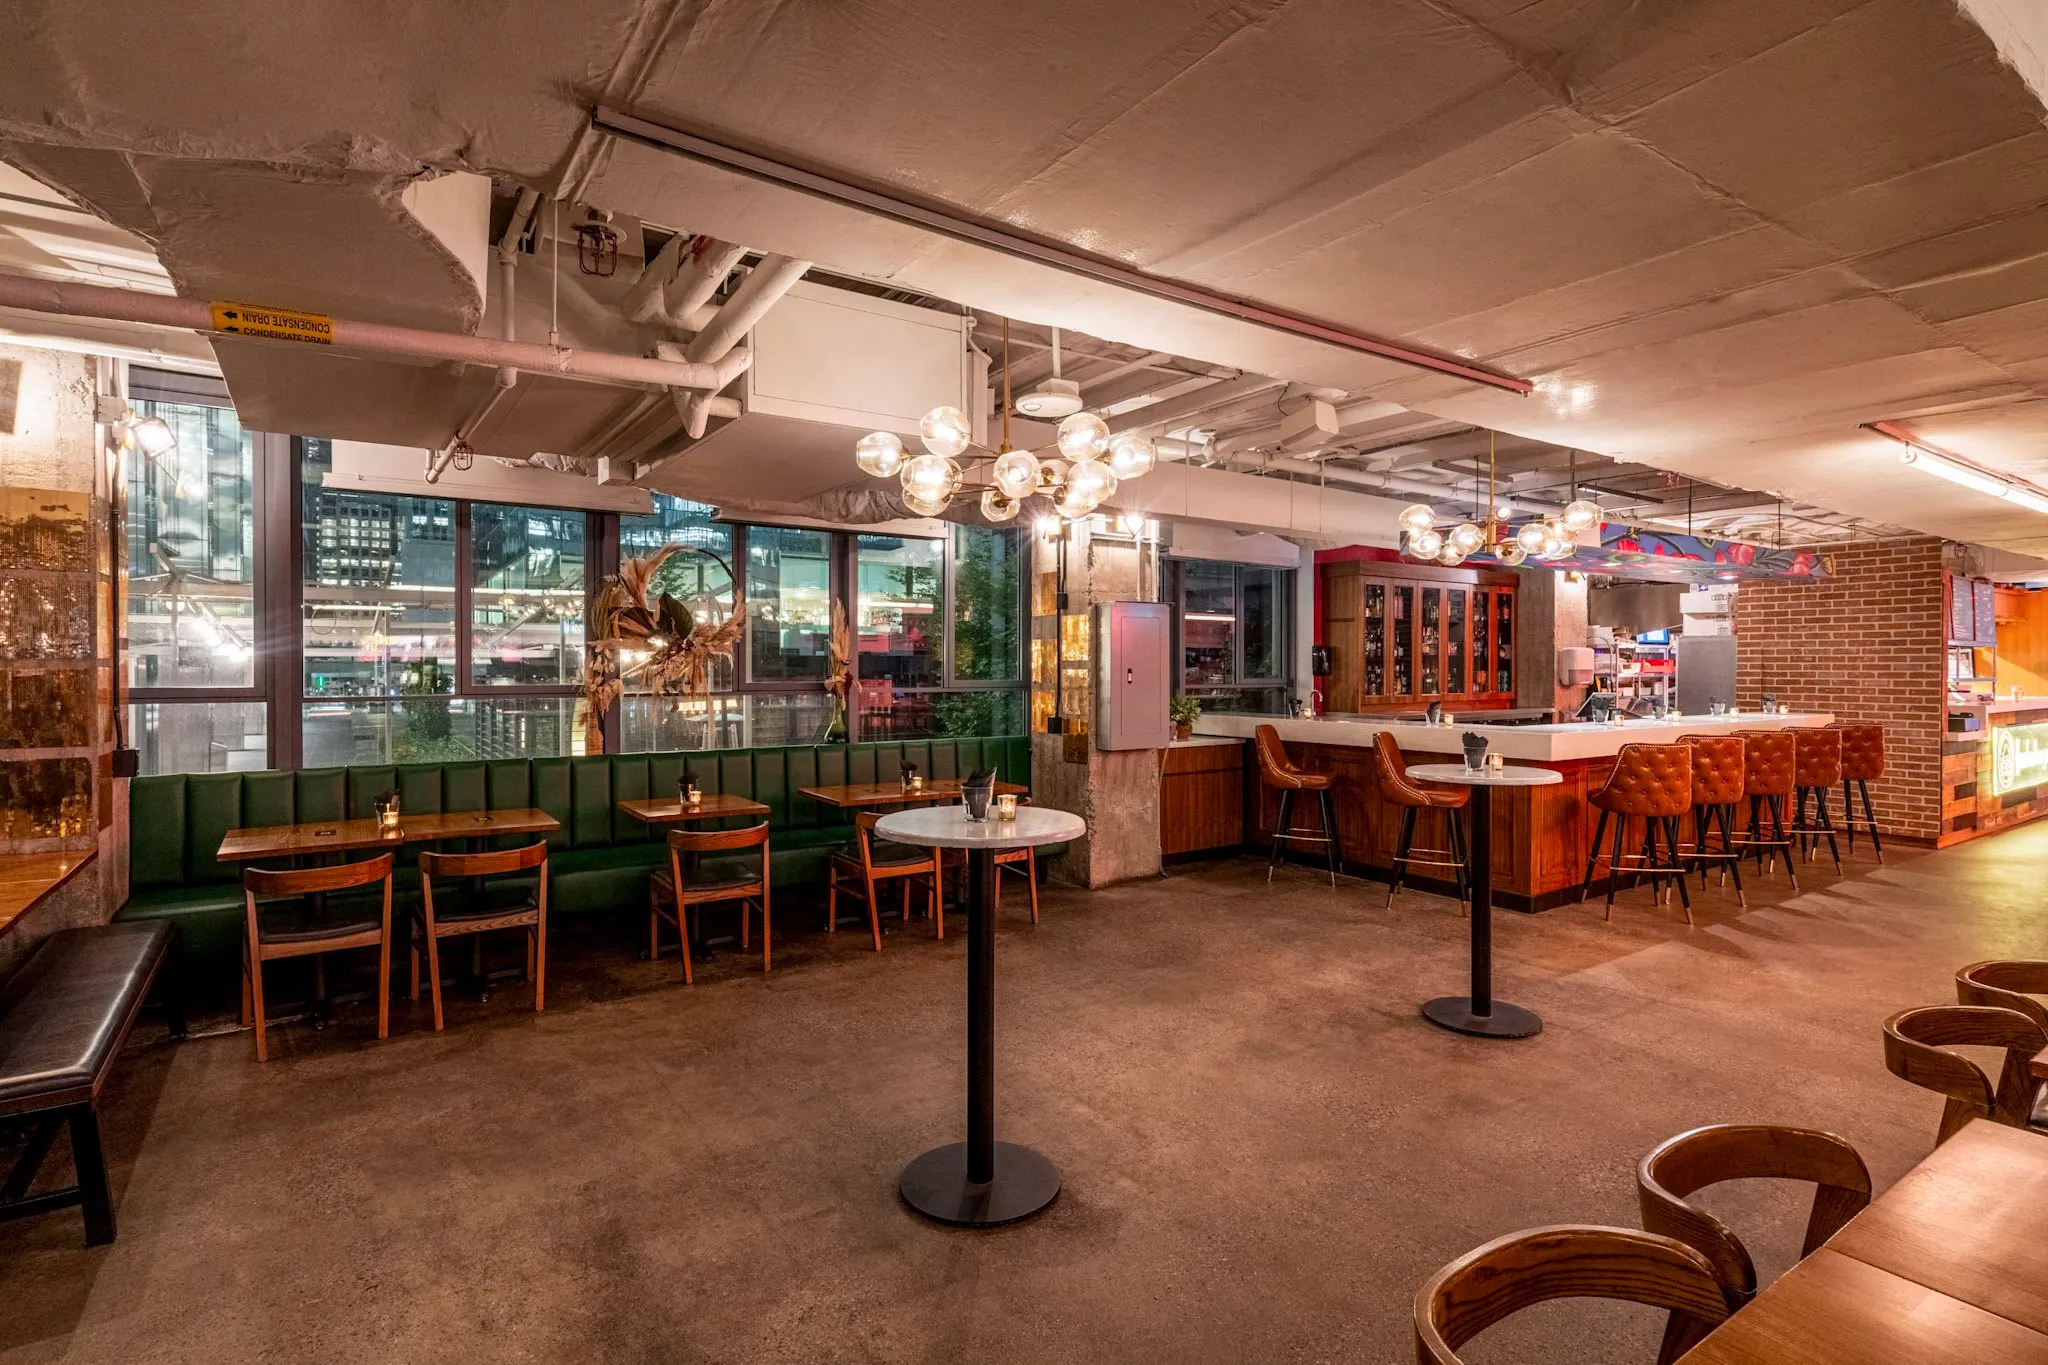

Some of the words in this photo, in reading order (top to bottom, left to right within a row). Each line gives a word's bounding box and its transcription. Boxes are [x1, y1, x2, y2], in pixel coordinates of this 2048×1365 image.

[242, 312, 270, 325] DRAIN
[272, 316, 330, 334] CONDENSATE
[243, 327, 302, 341] CONDENSATE
[304, 335, 331, 345] DRAIN
